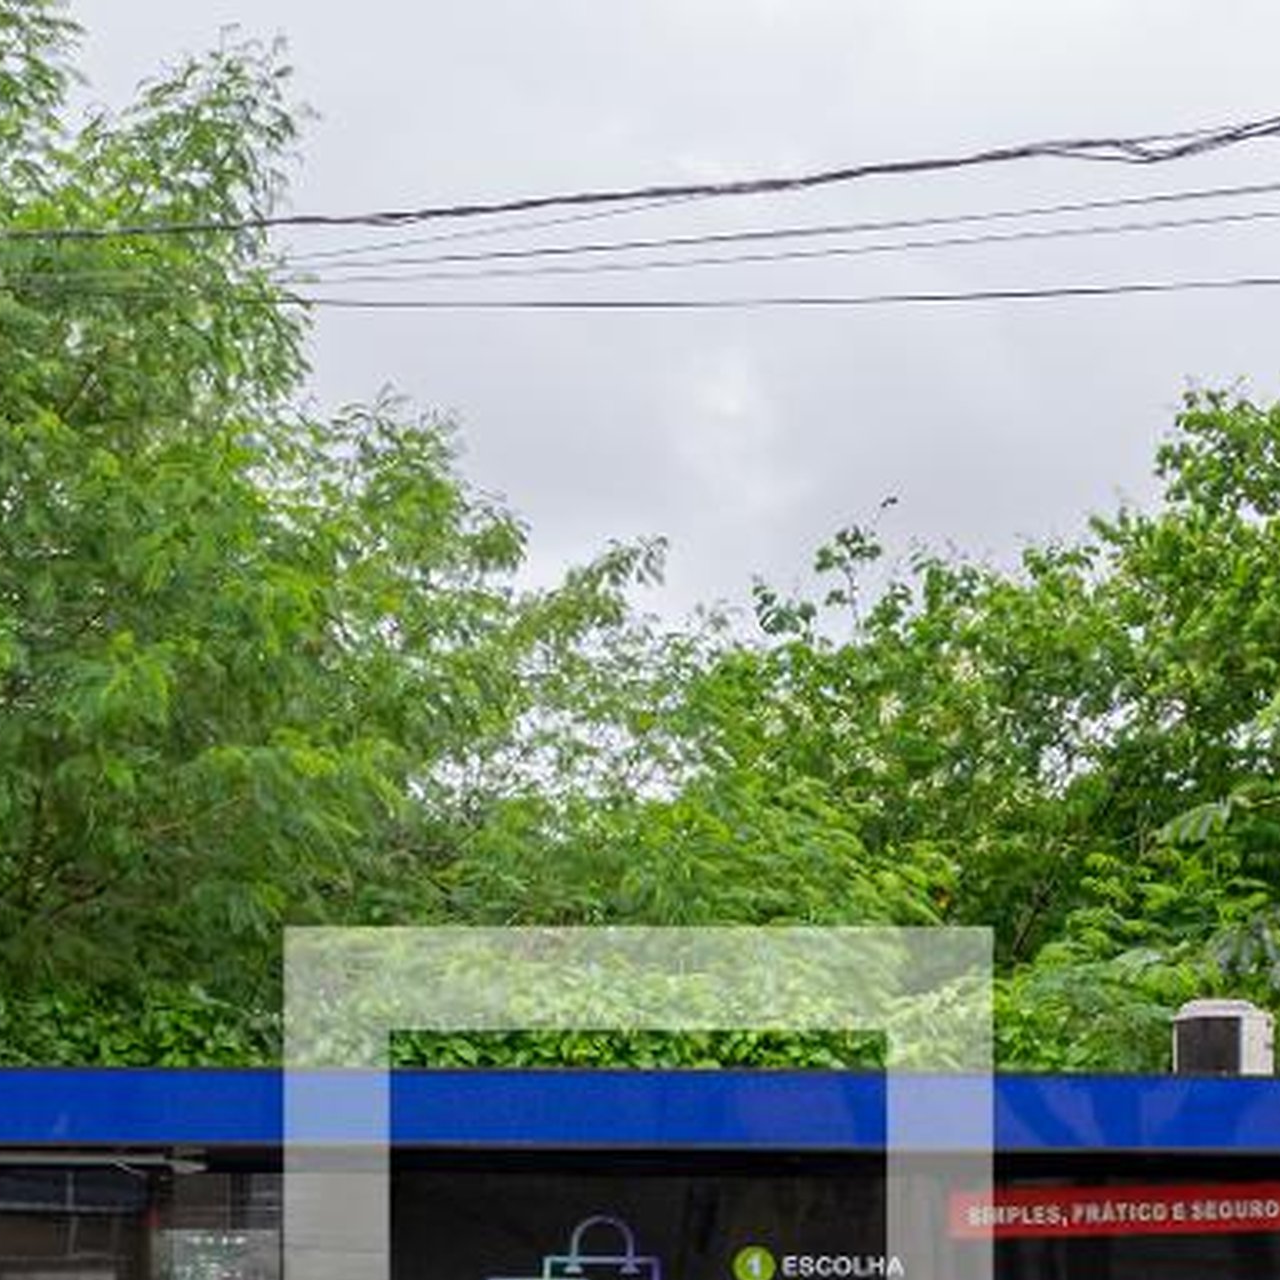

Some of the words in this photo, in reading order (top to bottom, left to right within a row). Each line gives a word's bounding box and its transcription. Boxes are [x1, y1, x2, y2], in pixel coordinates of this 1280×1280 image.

[968, 1204, 1068, 1227] SIMPLES,
[1071, 1199, 1166, 1223] PRÁTICO
[1172, 1200, 1186, 1221] E
[1190, 1199, 1280, 1220] SEGURO
[746, 1256, 762, 1278] 1
[781, 1255, 905, 1278] ESCOLHA
